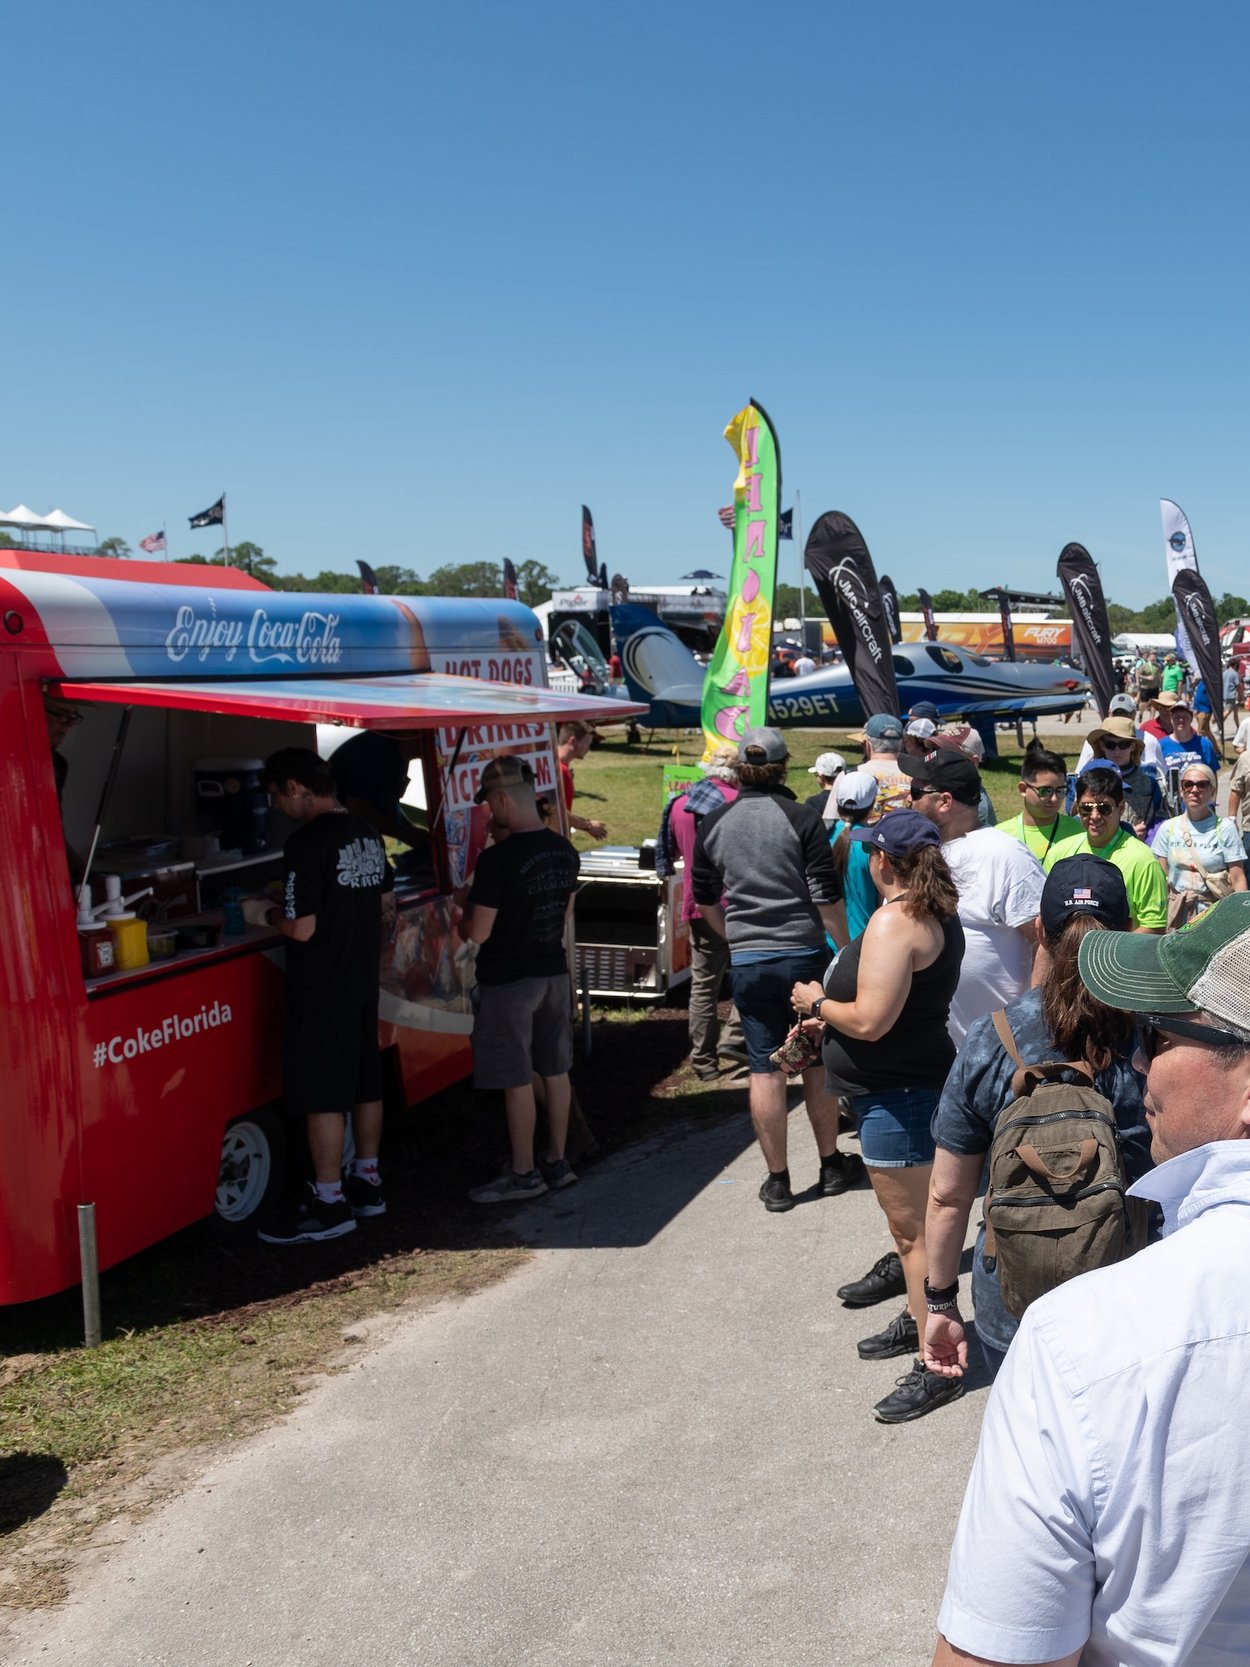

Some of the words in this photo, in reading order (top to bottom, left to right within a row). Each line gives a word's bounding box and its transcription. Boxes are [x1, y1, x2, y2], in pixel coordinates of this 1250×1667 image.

[165, 605, 243, 663] Enjoy
[1024, 627, 1066, 638] FURY
[488, 657, 533, 687] DOGS
[446, 722, 546, 748] DRINKS
[451, 768, 481, 804] ICE
[93, 1000, 232, 1068] #CokeFlorida
